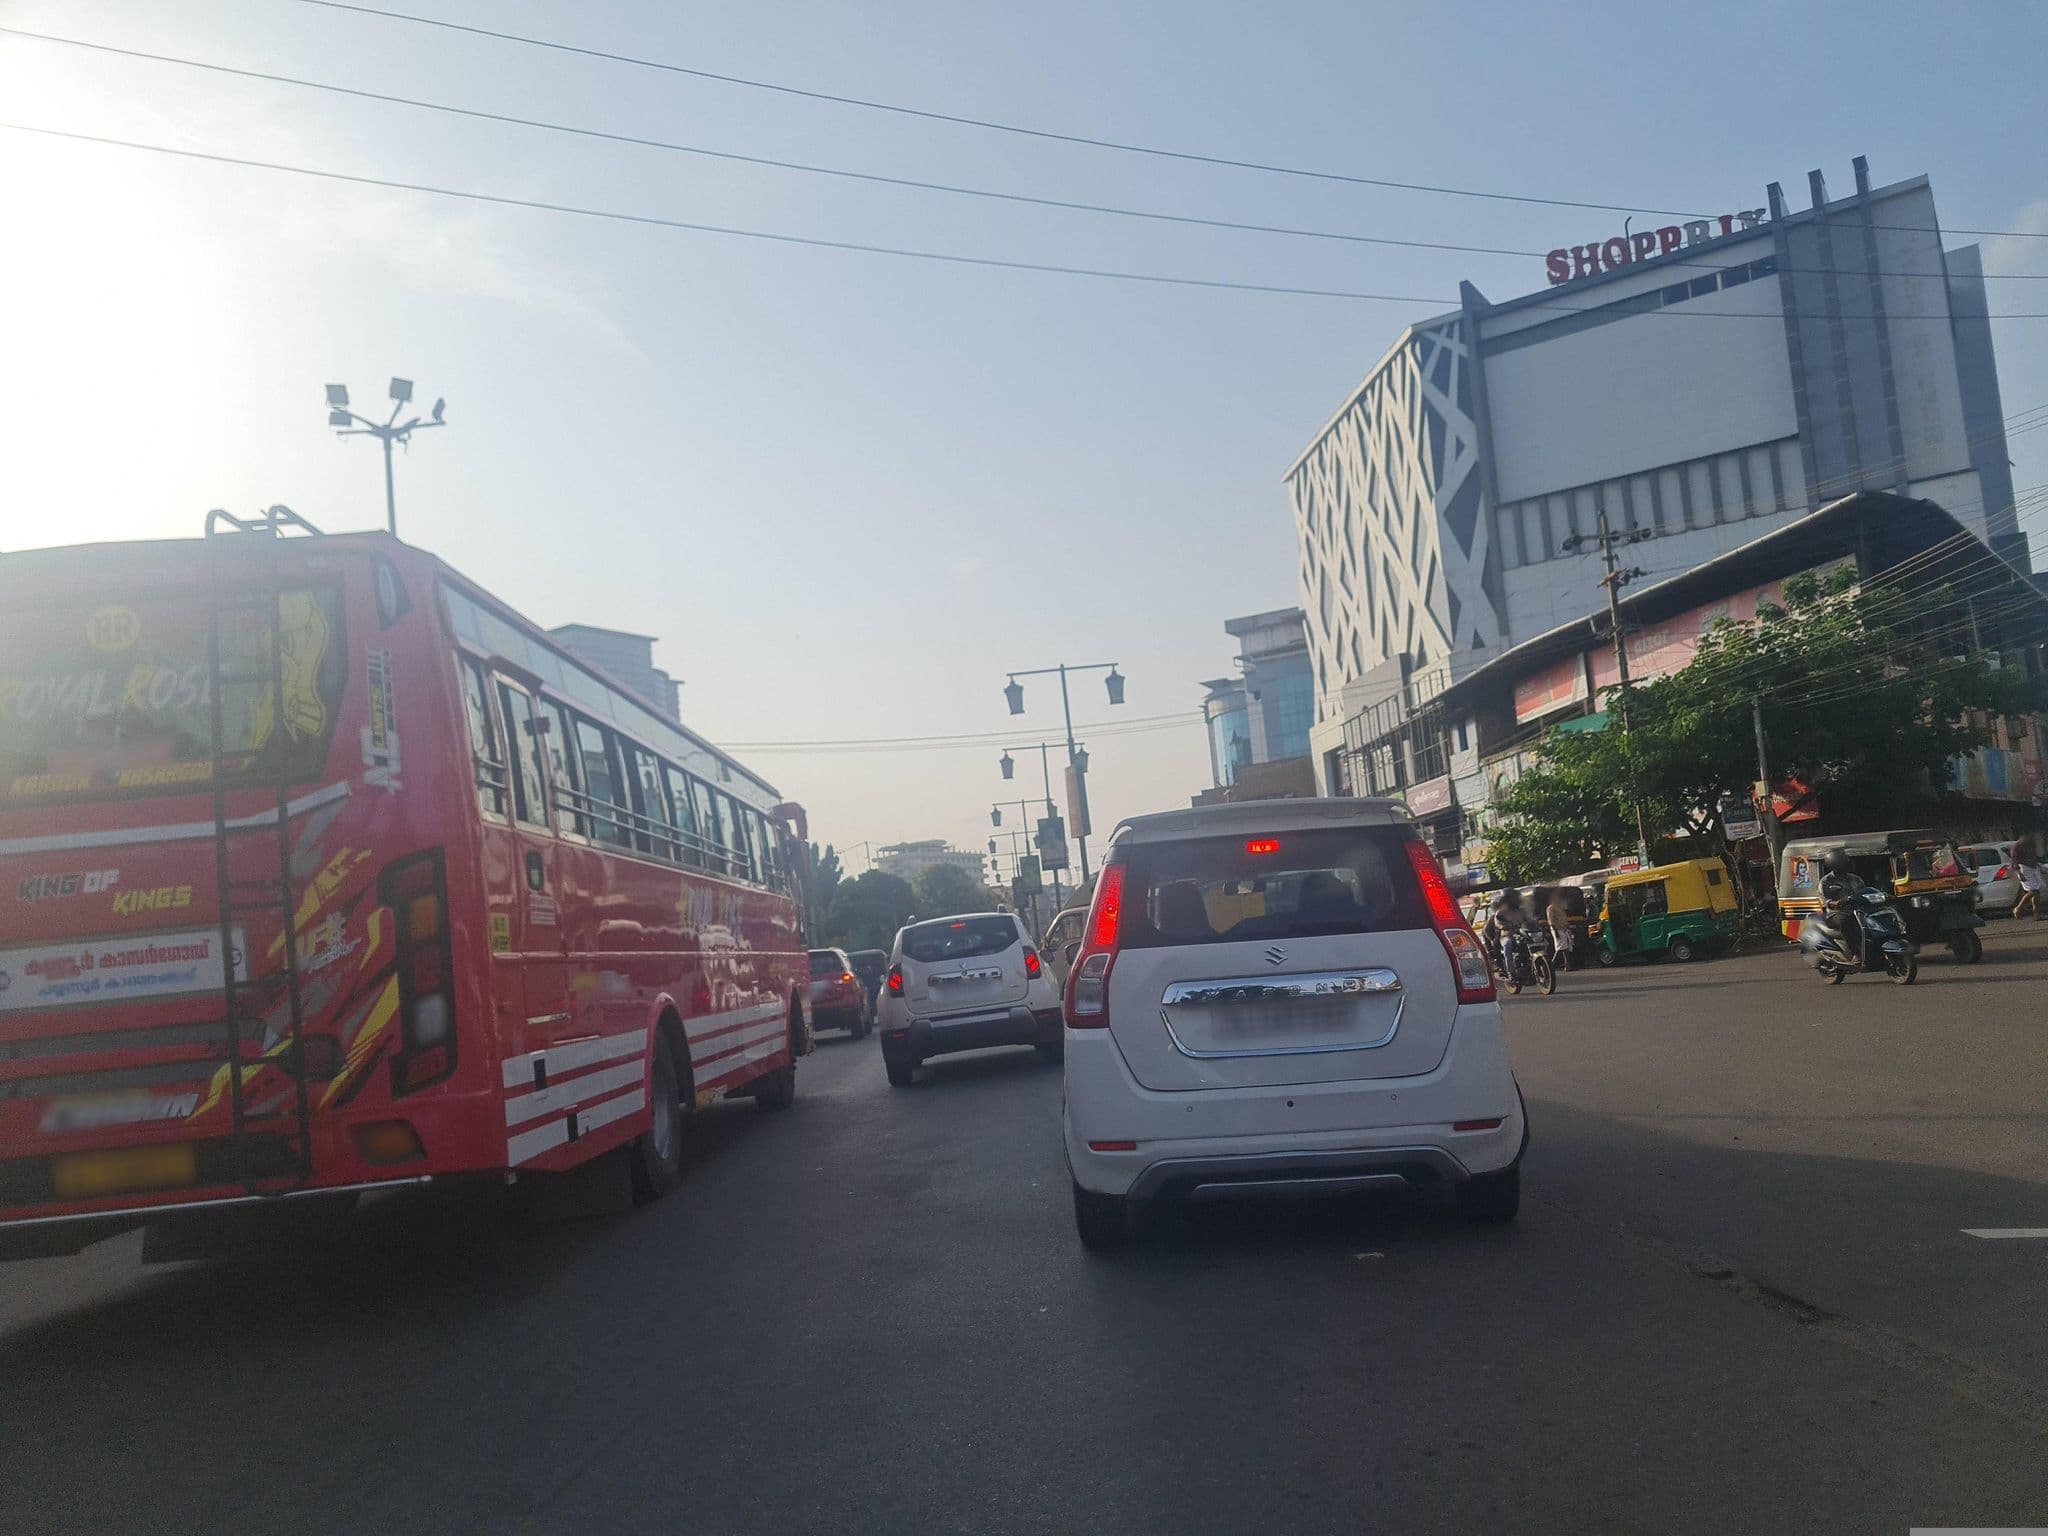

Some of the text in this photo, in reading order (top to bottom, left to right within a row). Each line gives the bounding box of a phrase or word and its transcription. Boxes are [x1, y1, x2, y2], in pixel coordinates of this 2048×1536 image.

[16, 869, 119, 903] KING OF
[114, 886, 192, 917] KINGS
